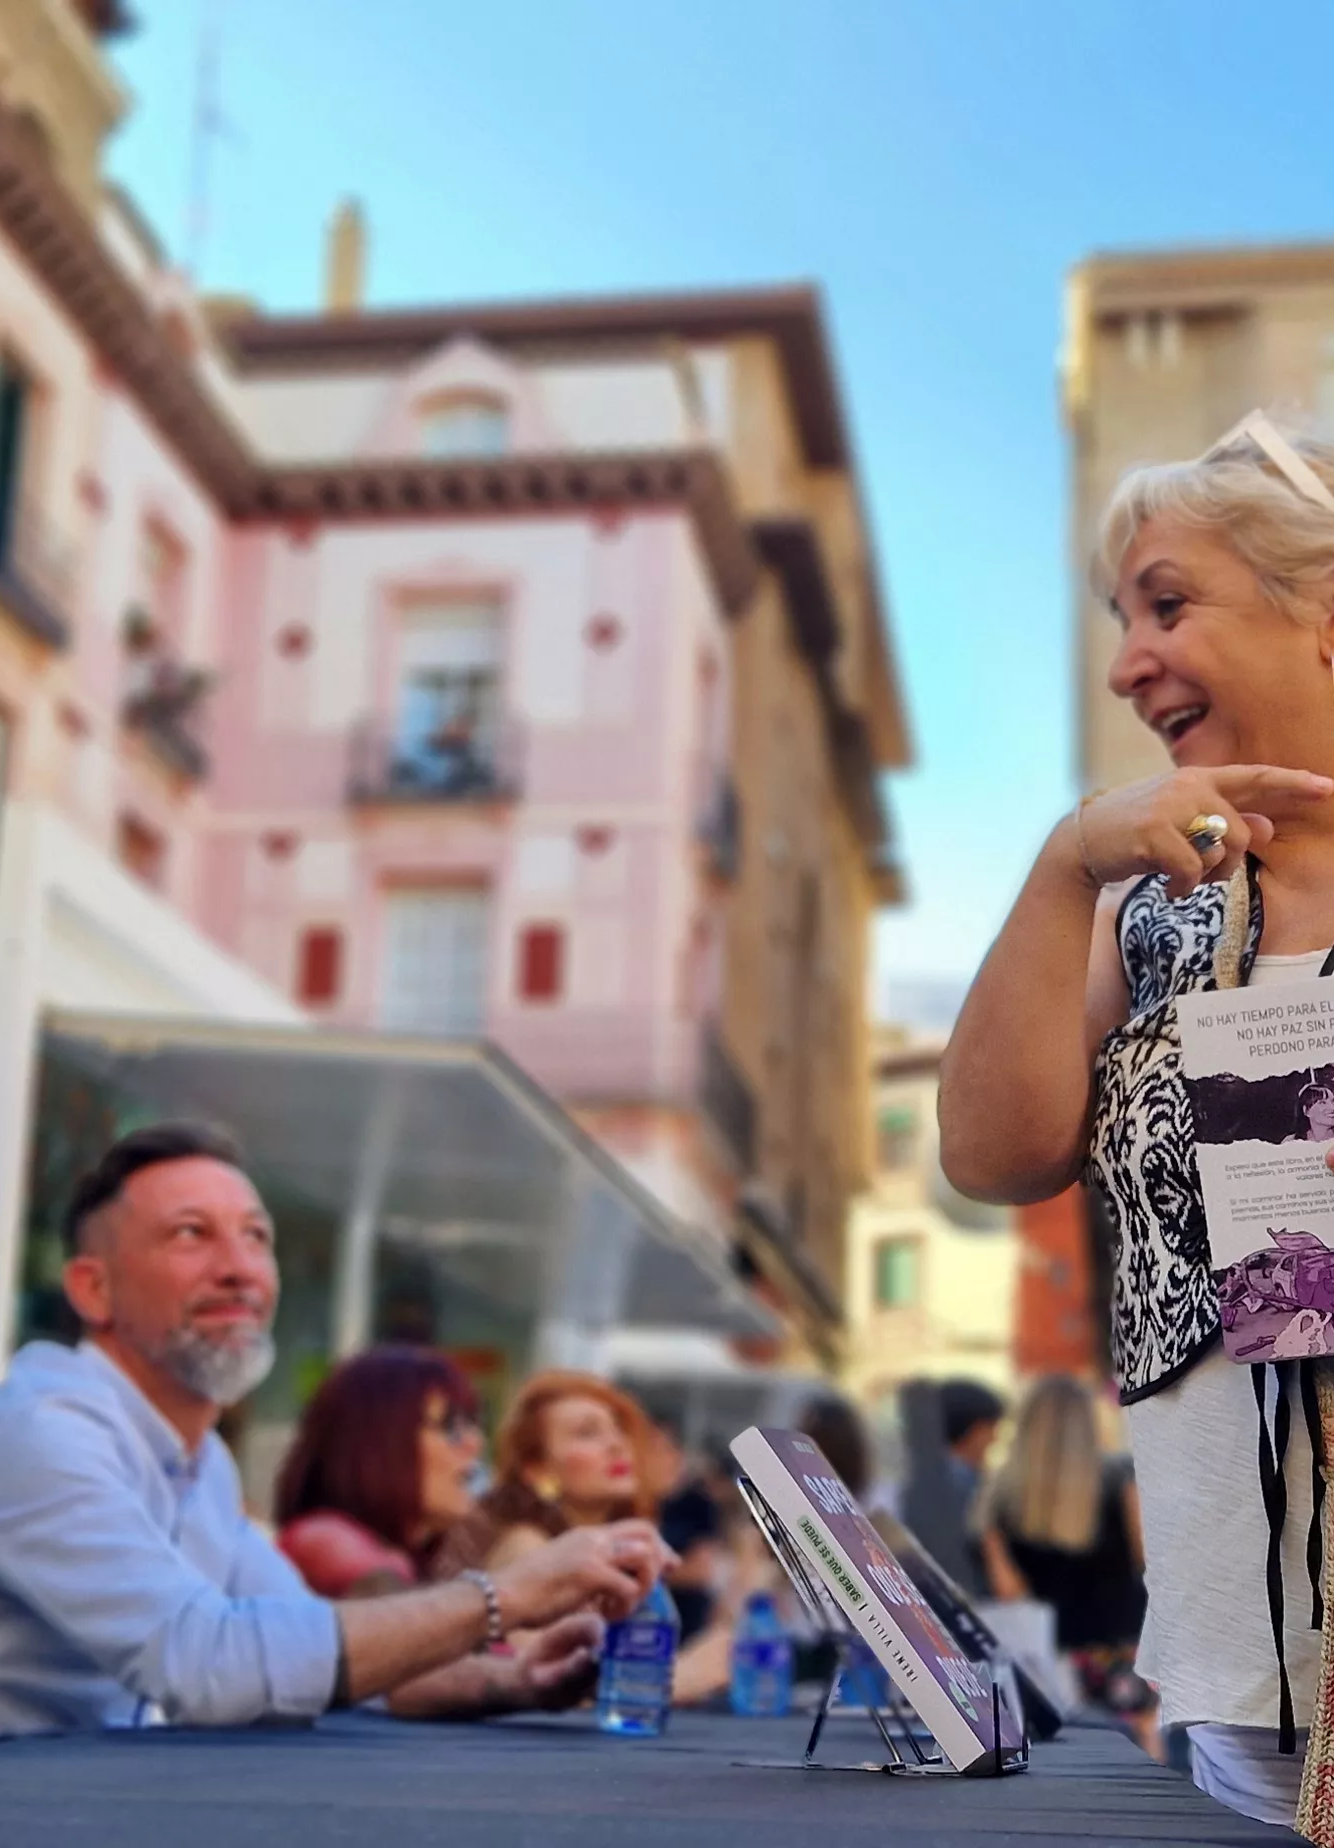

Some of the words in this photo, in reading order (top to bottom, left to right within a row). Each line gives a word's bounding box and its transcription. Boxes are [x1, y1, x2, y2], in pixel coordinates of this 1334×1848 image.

[1197, 1016, 1213, 1028] NO
[1217, 1012, 1237, 1026] HAY
[1241, 1006, 1284, 1023] TIEMPO
[1288, 1003, 1317, 1017] PARA
[1320, 1000, 1334, 1013] EL
[1237, 1028, 1254, 1041] NO
[1257, 1025, 1278, 1039] HAY
[1282, 1021, 1303, 1035] PAZ
[1306, 1018, 1326, 1032] SIN
[1249, 1039, 1305, 1057] PERDONO
[800, 1519, 822, 1548] PUEDE
[818, 1545, 831, 1558] SE
[826, 1555, 844, 1577] QUE
[838, 1571, 862, 1602] SABER
[867, 1613, 893, 1648] VILLA
[891, 1649, 919, 1683] IRENE
